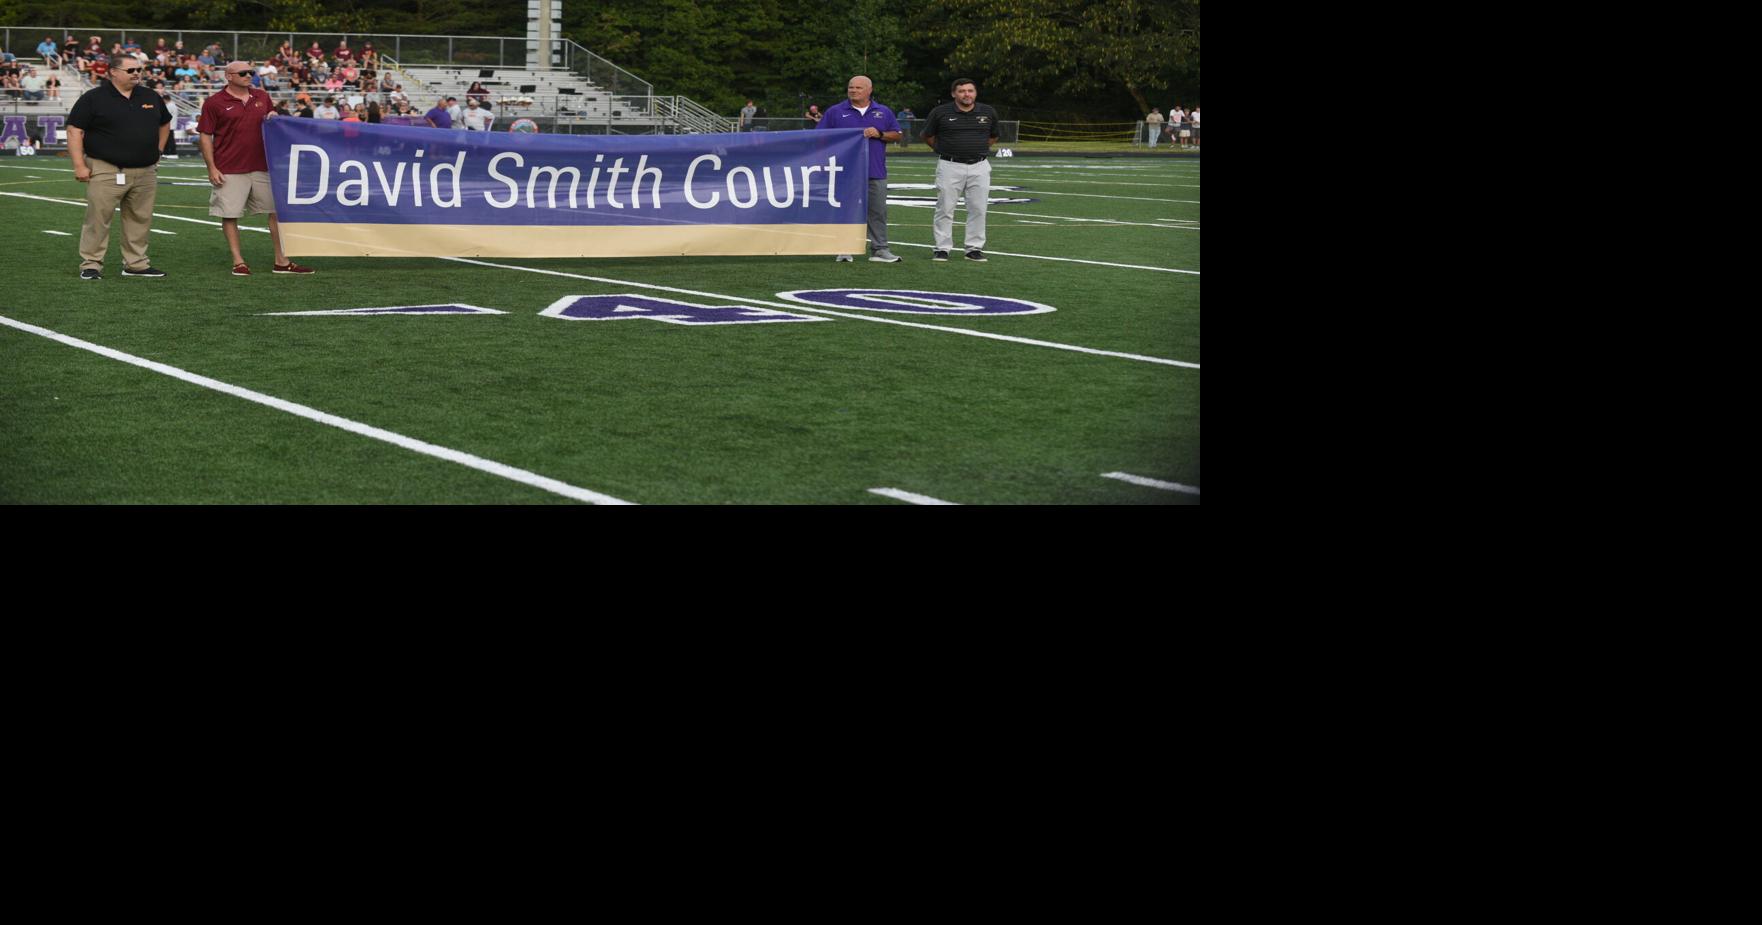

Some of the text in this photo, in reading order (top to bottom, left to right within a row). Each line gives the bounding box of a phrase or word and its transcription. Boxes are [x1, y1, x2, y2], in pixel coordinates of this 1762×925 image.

[20, 145, 36, 156] 50
[1001, 148, 1014, 158] 20
[286, 143, 844, 210] David Smith Court
